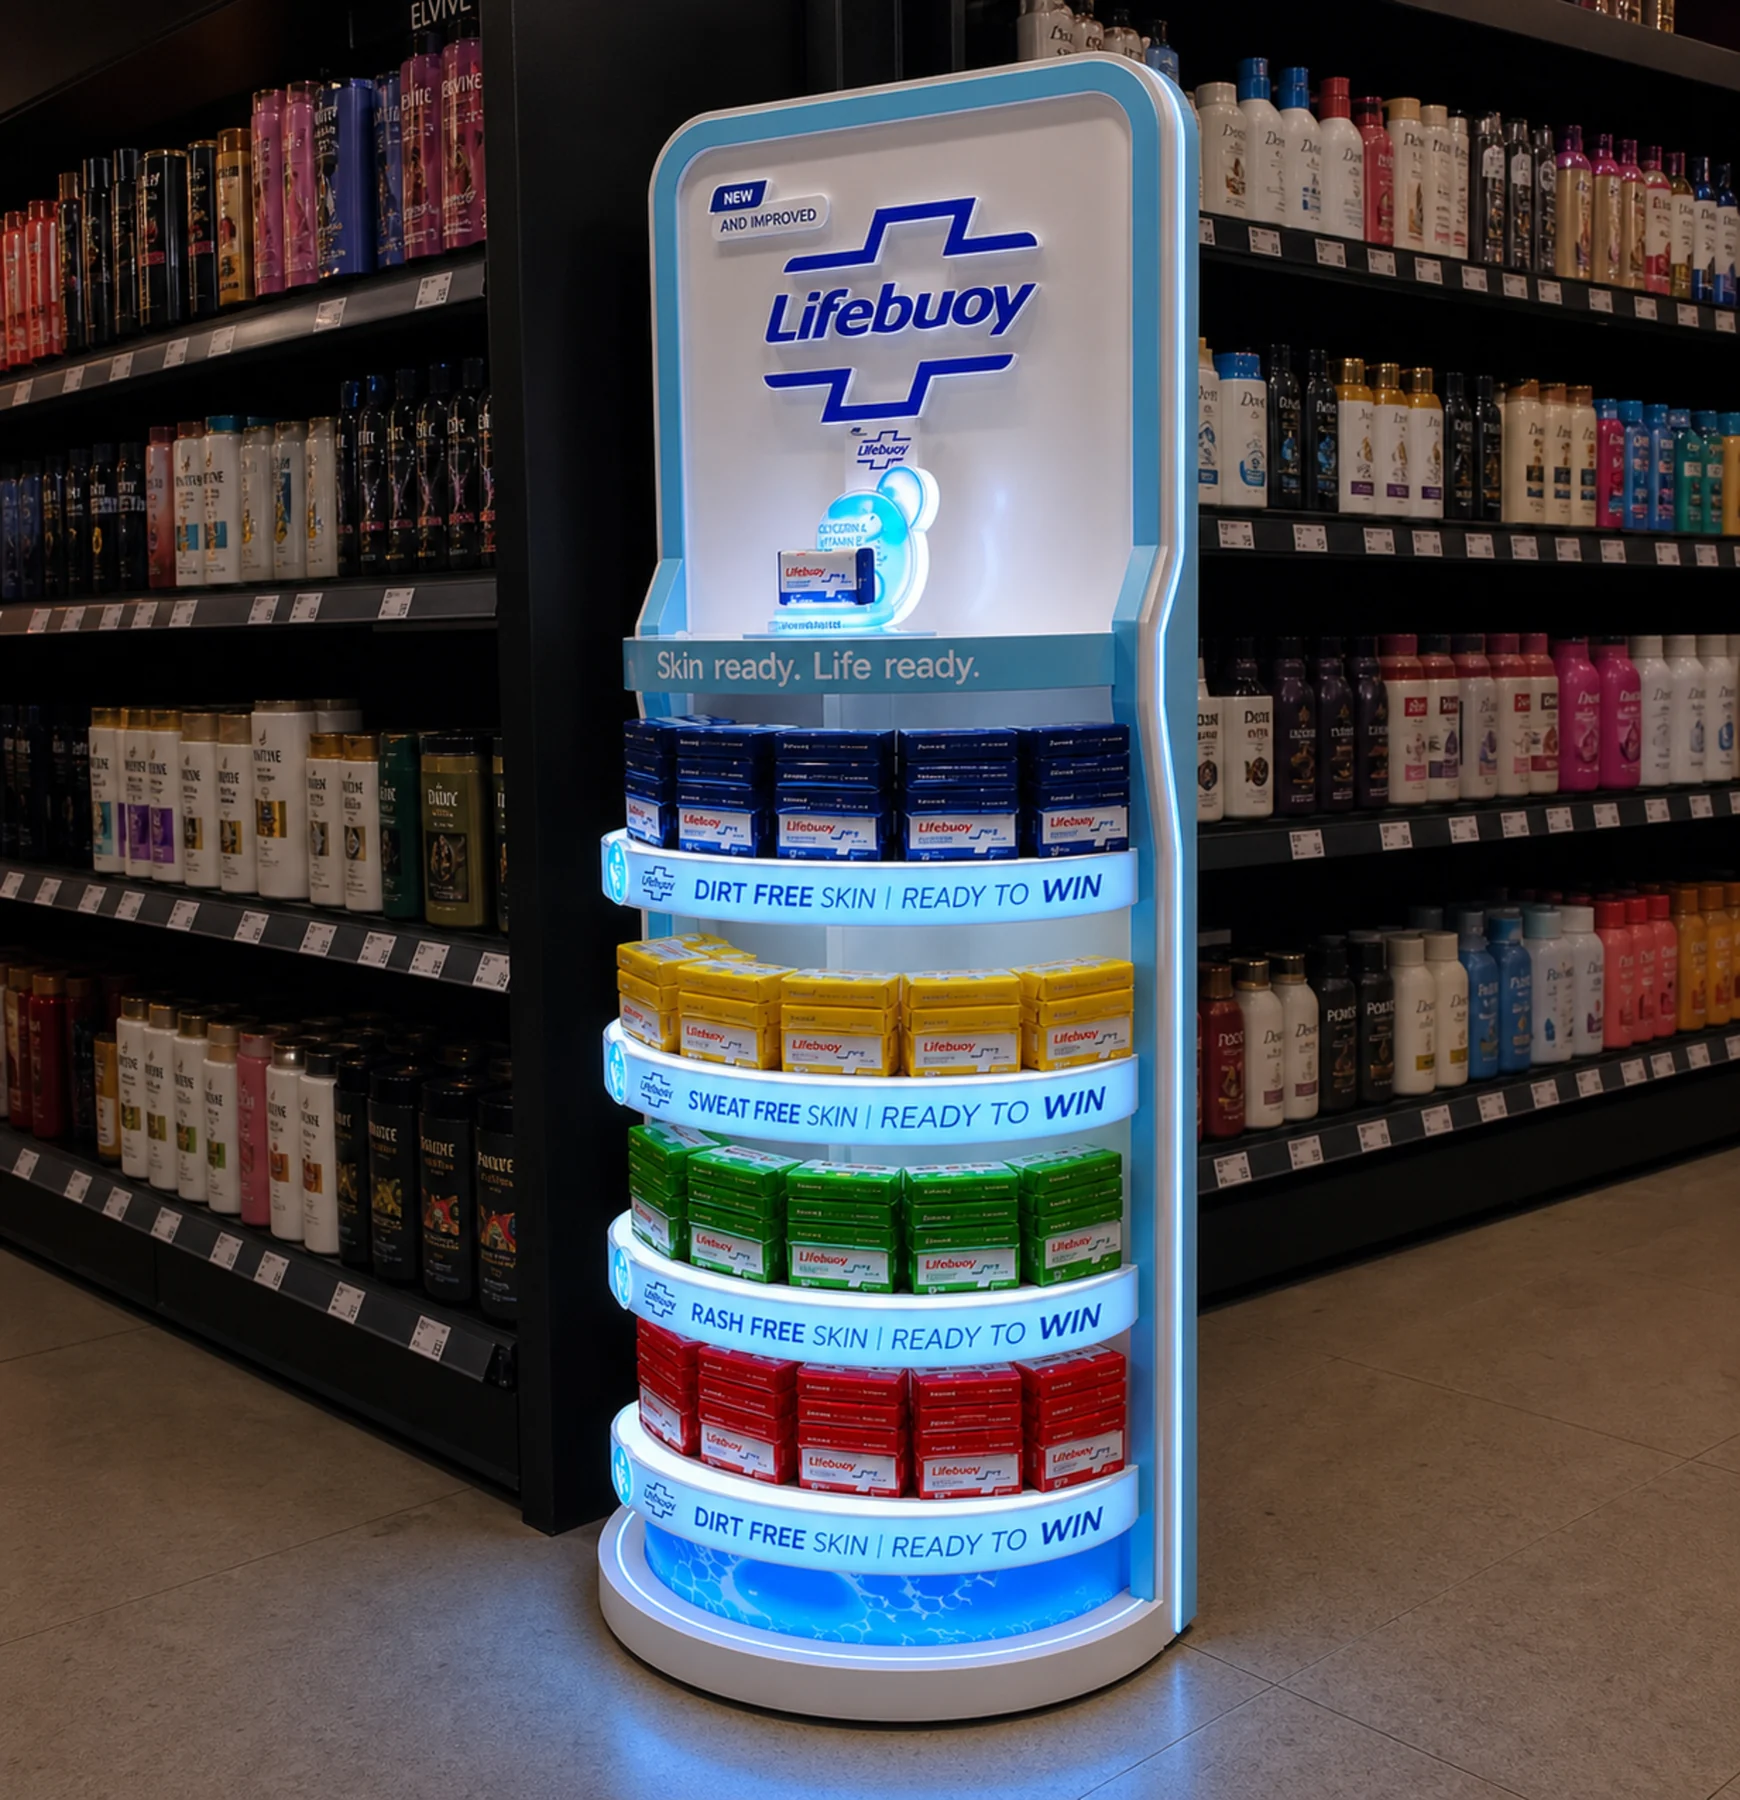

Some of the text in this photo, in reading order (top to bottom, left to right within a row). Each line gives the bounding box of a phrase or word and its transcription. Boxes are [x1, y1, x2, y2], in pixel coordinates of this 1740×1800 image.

[723, 189, 753, 205] NEW
[720, 208, 817, 232] AND IMPROVED
[766, 283, 1037, 343] Lifebuoy
[657, 650, 980, 687] Skin ready. Life ready.
[918, 822, 973, 834] Lifebuoy
[694, 873, 1102, 909] DIRT FREE SKIN READY TO WIN
[792, 1039, 841, 1054] Lifebuoy
[923, 1042, 976, 1053] Lifebuoy
[688, 1086, 1107, 1129] SWEAT FREE SKIN READY TO WIN
[691, 1302, 1102, 1350] RASH FREE SKIN READY TO WIN
[694, 1506, 1104, 1557] DIRT FREE SKIN READY TO WIN
